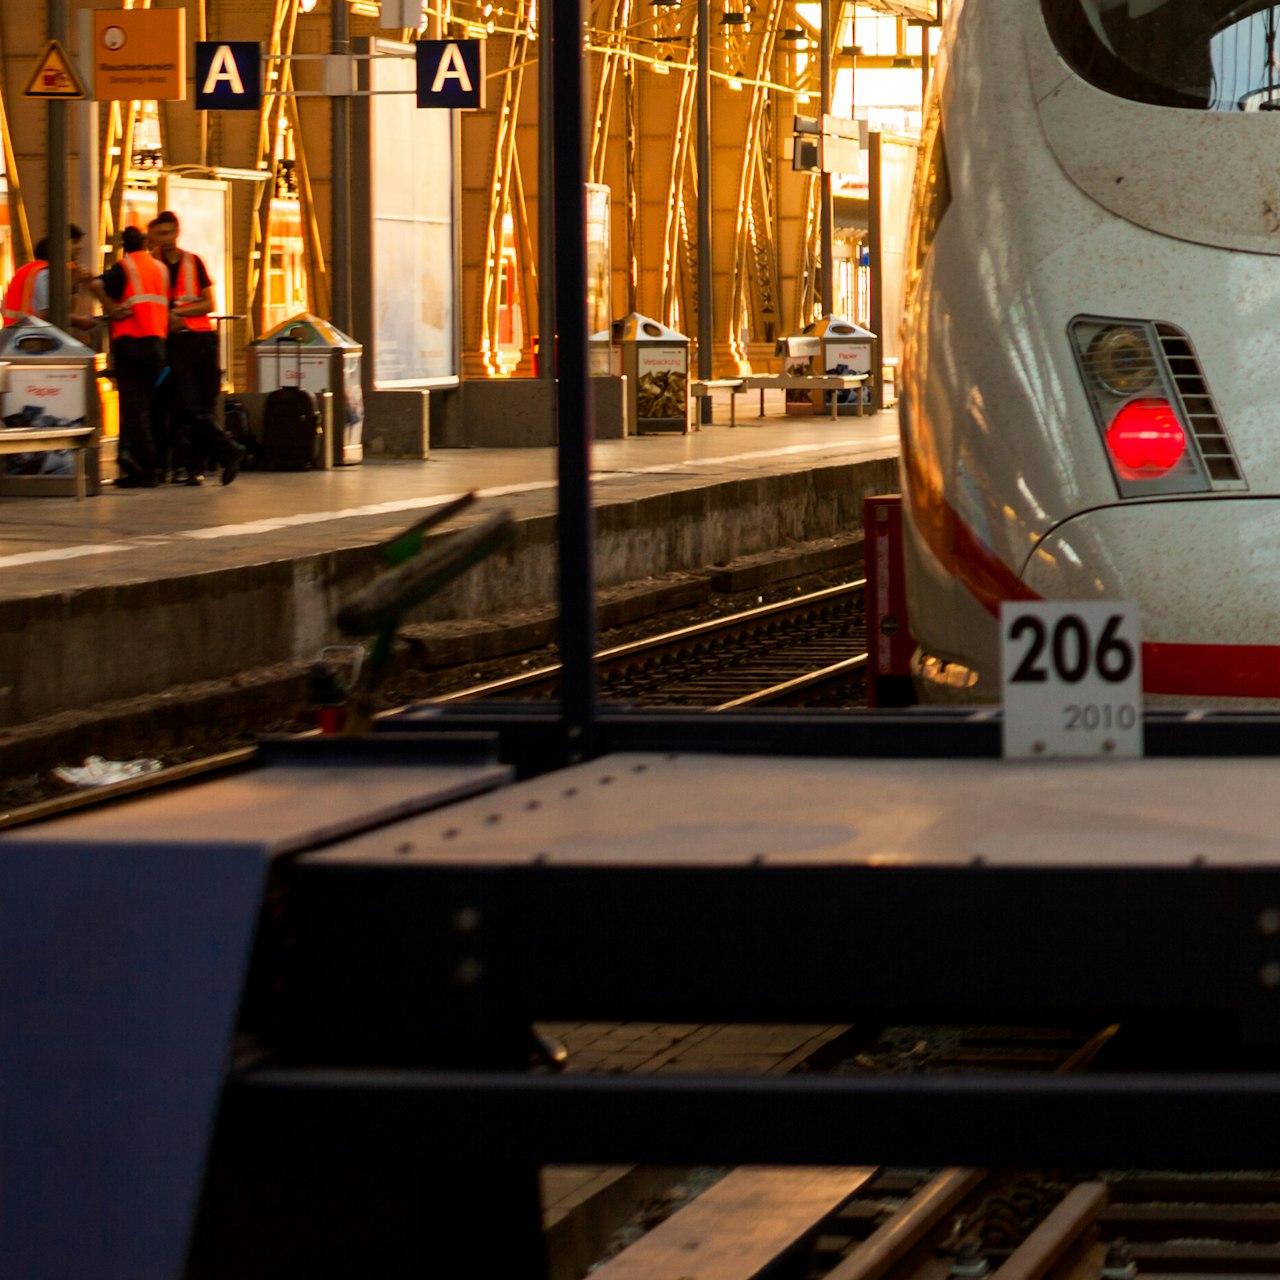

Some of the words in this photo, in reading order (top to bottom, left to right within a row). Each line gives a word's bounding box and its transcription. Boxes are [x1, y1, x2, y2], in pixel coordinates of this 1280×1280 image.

[203, 45, 246, 94] A
[430, 42, 473, 93] A
[1008, 615, 1135, 685] 206
[1063, 704, 1136, 731] 2010
